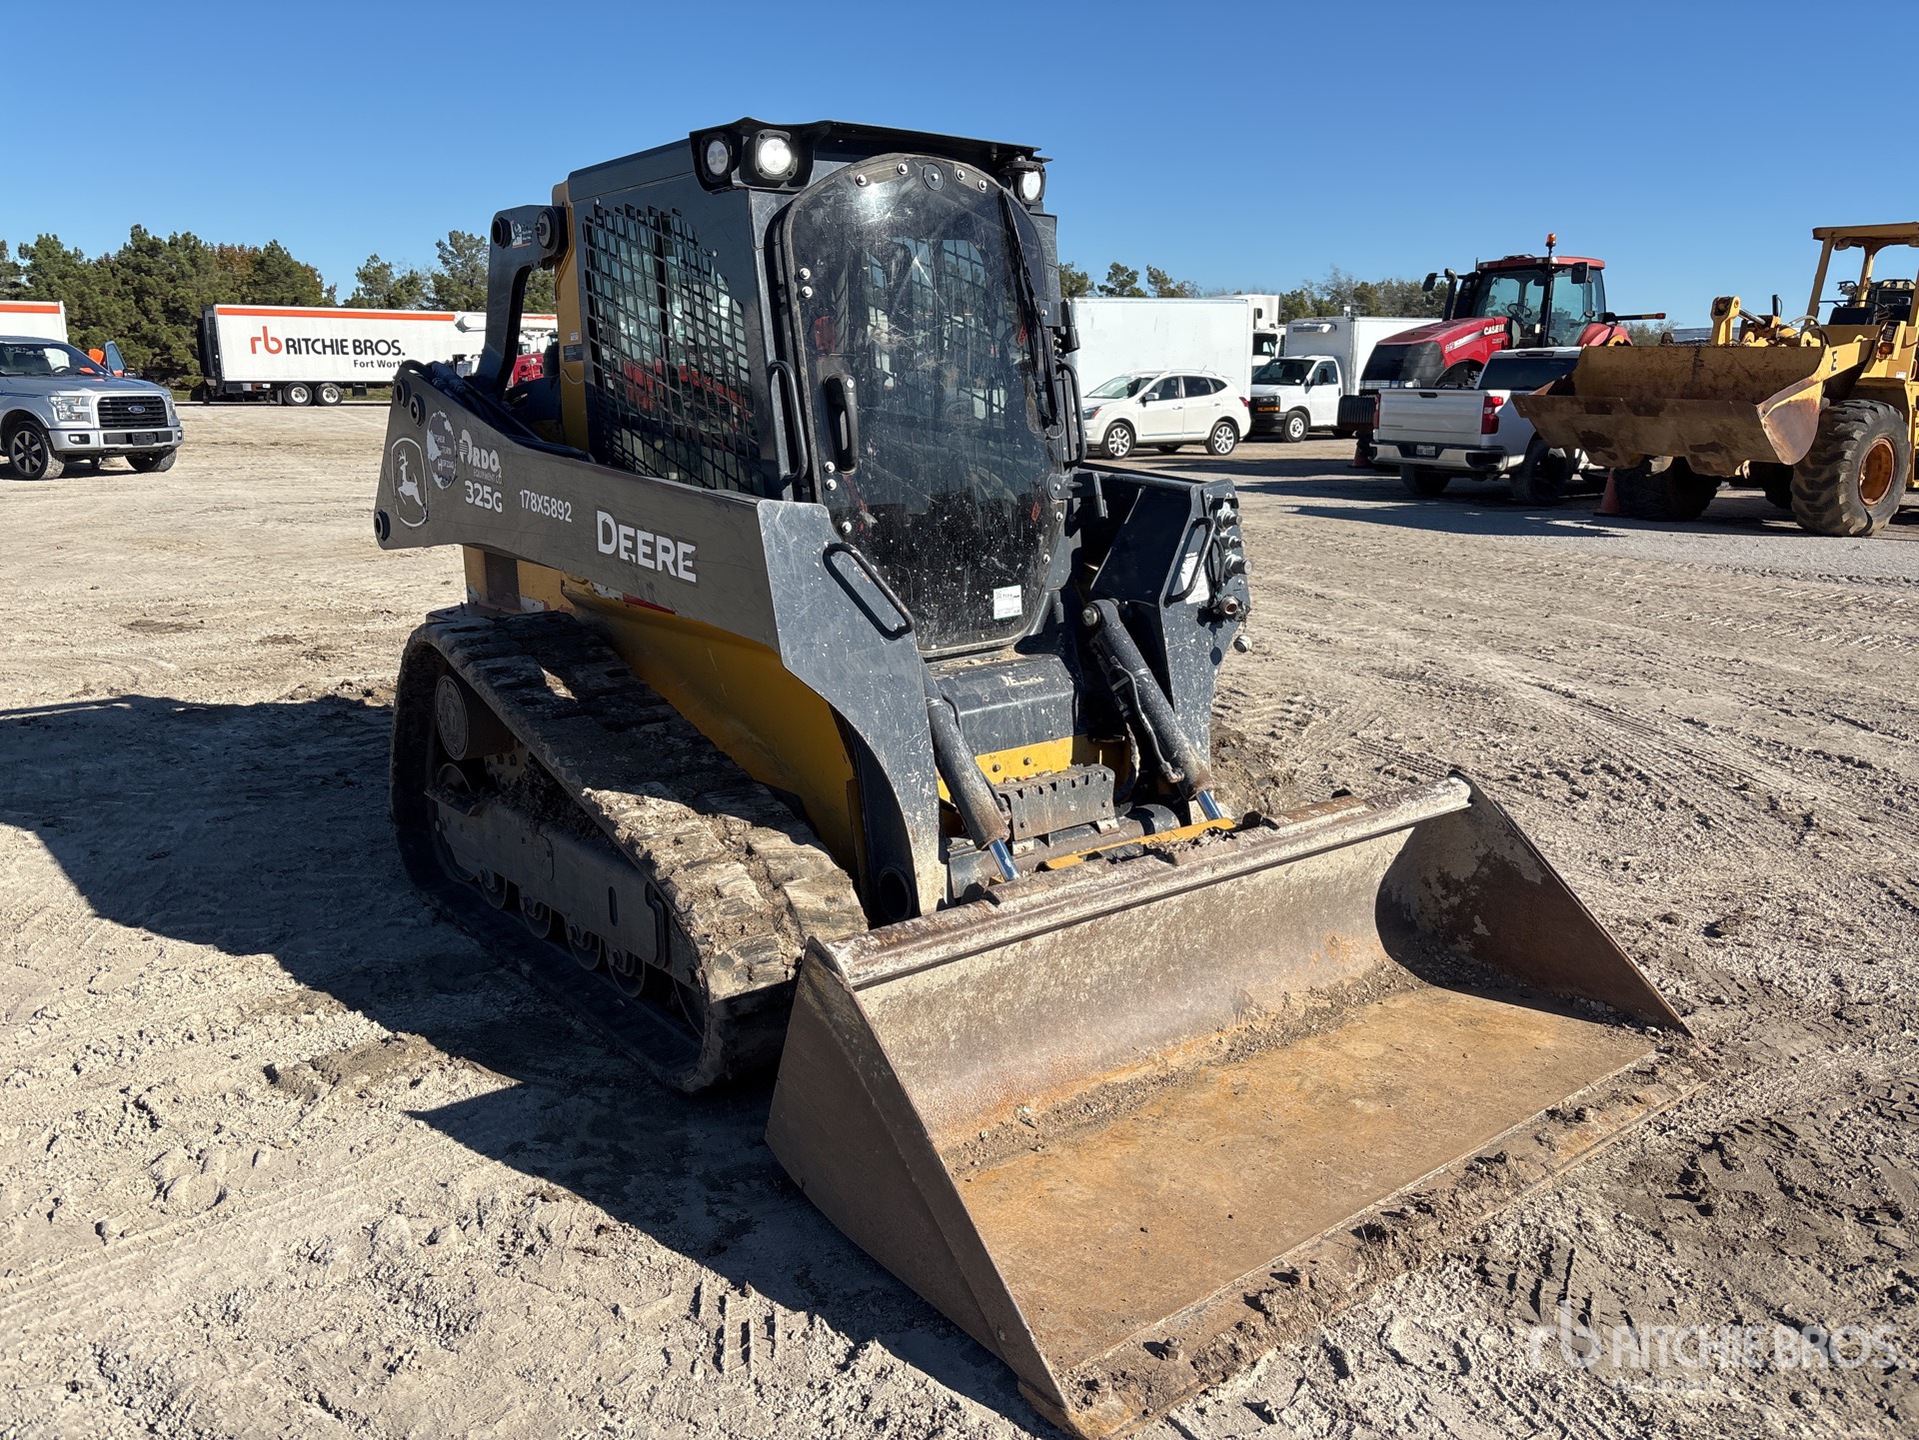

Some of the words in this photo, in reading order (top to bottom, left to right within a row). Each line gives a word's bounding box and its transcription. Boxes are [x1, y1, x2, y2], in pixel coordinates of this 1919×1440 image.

[250, 325, 283, 355] rb
[285, 338, 349, 356] RITCHIE
[353, 338, 406, 356] BROS.
[353, 359, 375, 368] Fort
[377, 359, 403, 368] Wort
[464, 480, 503, 513] 325G
[519, 489, 573, 523] 178X5892
[596, 510, 698, 583] DEERE
